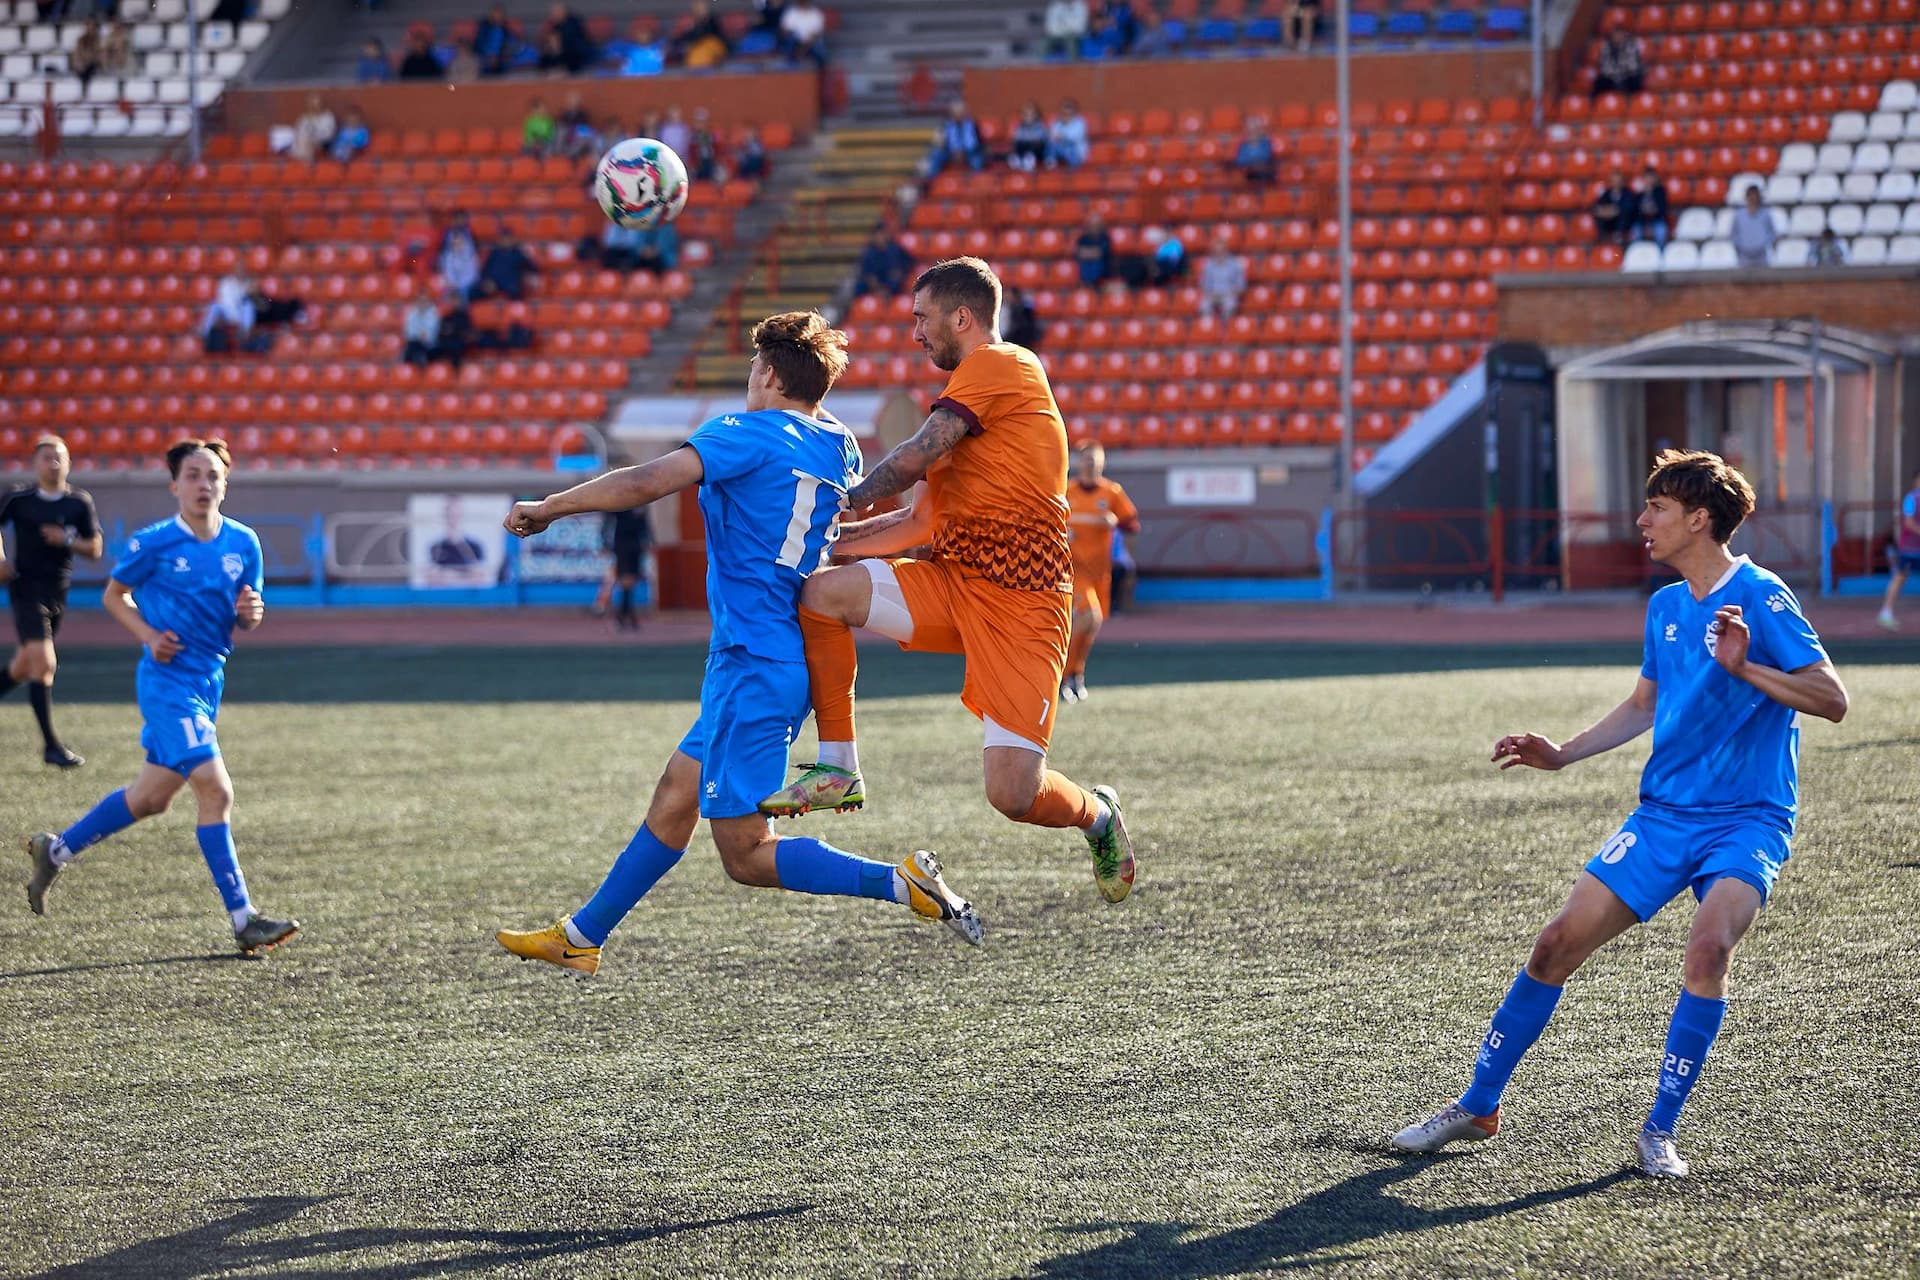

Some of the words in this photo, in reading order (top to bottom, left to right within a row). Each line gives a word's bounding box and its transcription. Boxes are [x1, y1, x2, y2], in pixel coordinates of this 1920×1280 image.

[1599, 829, 1638, 865] 6
[1487, 1026, 1505, 1049] 6
[1664, 1052, 1694, 1077] 26
